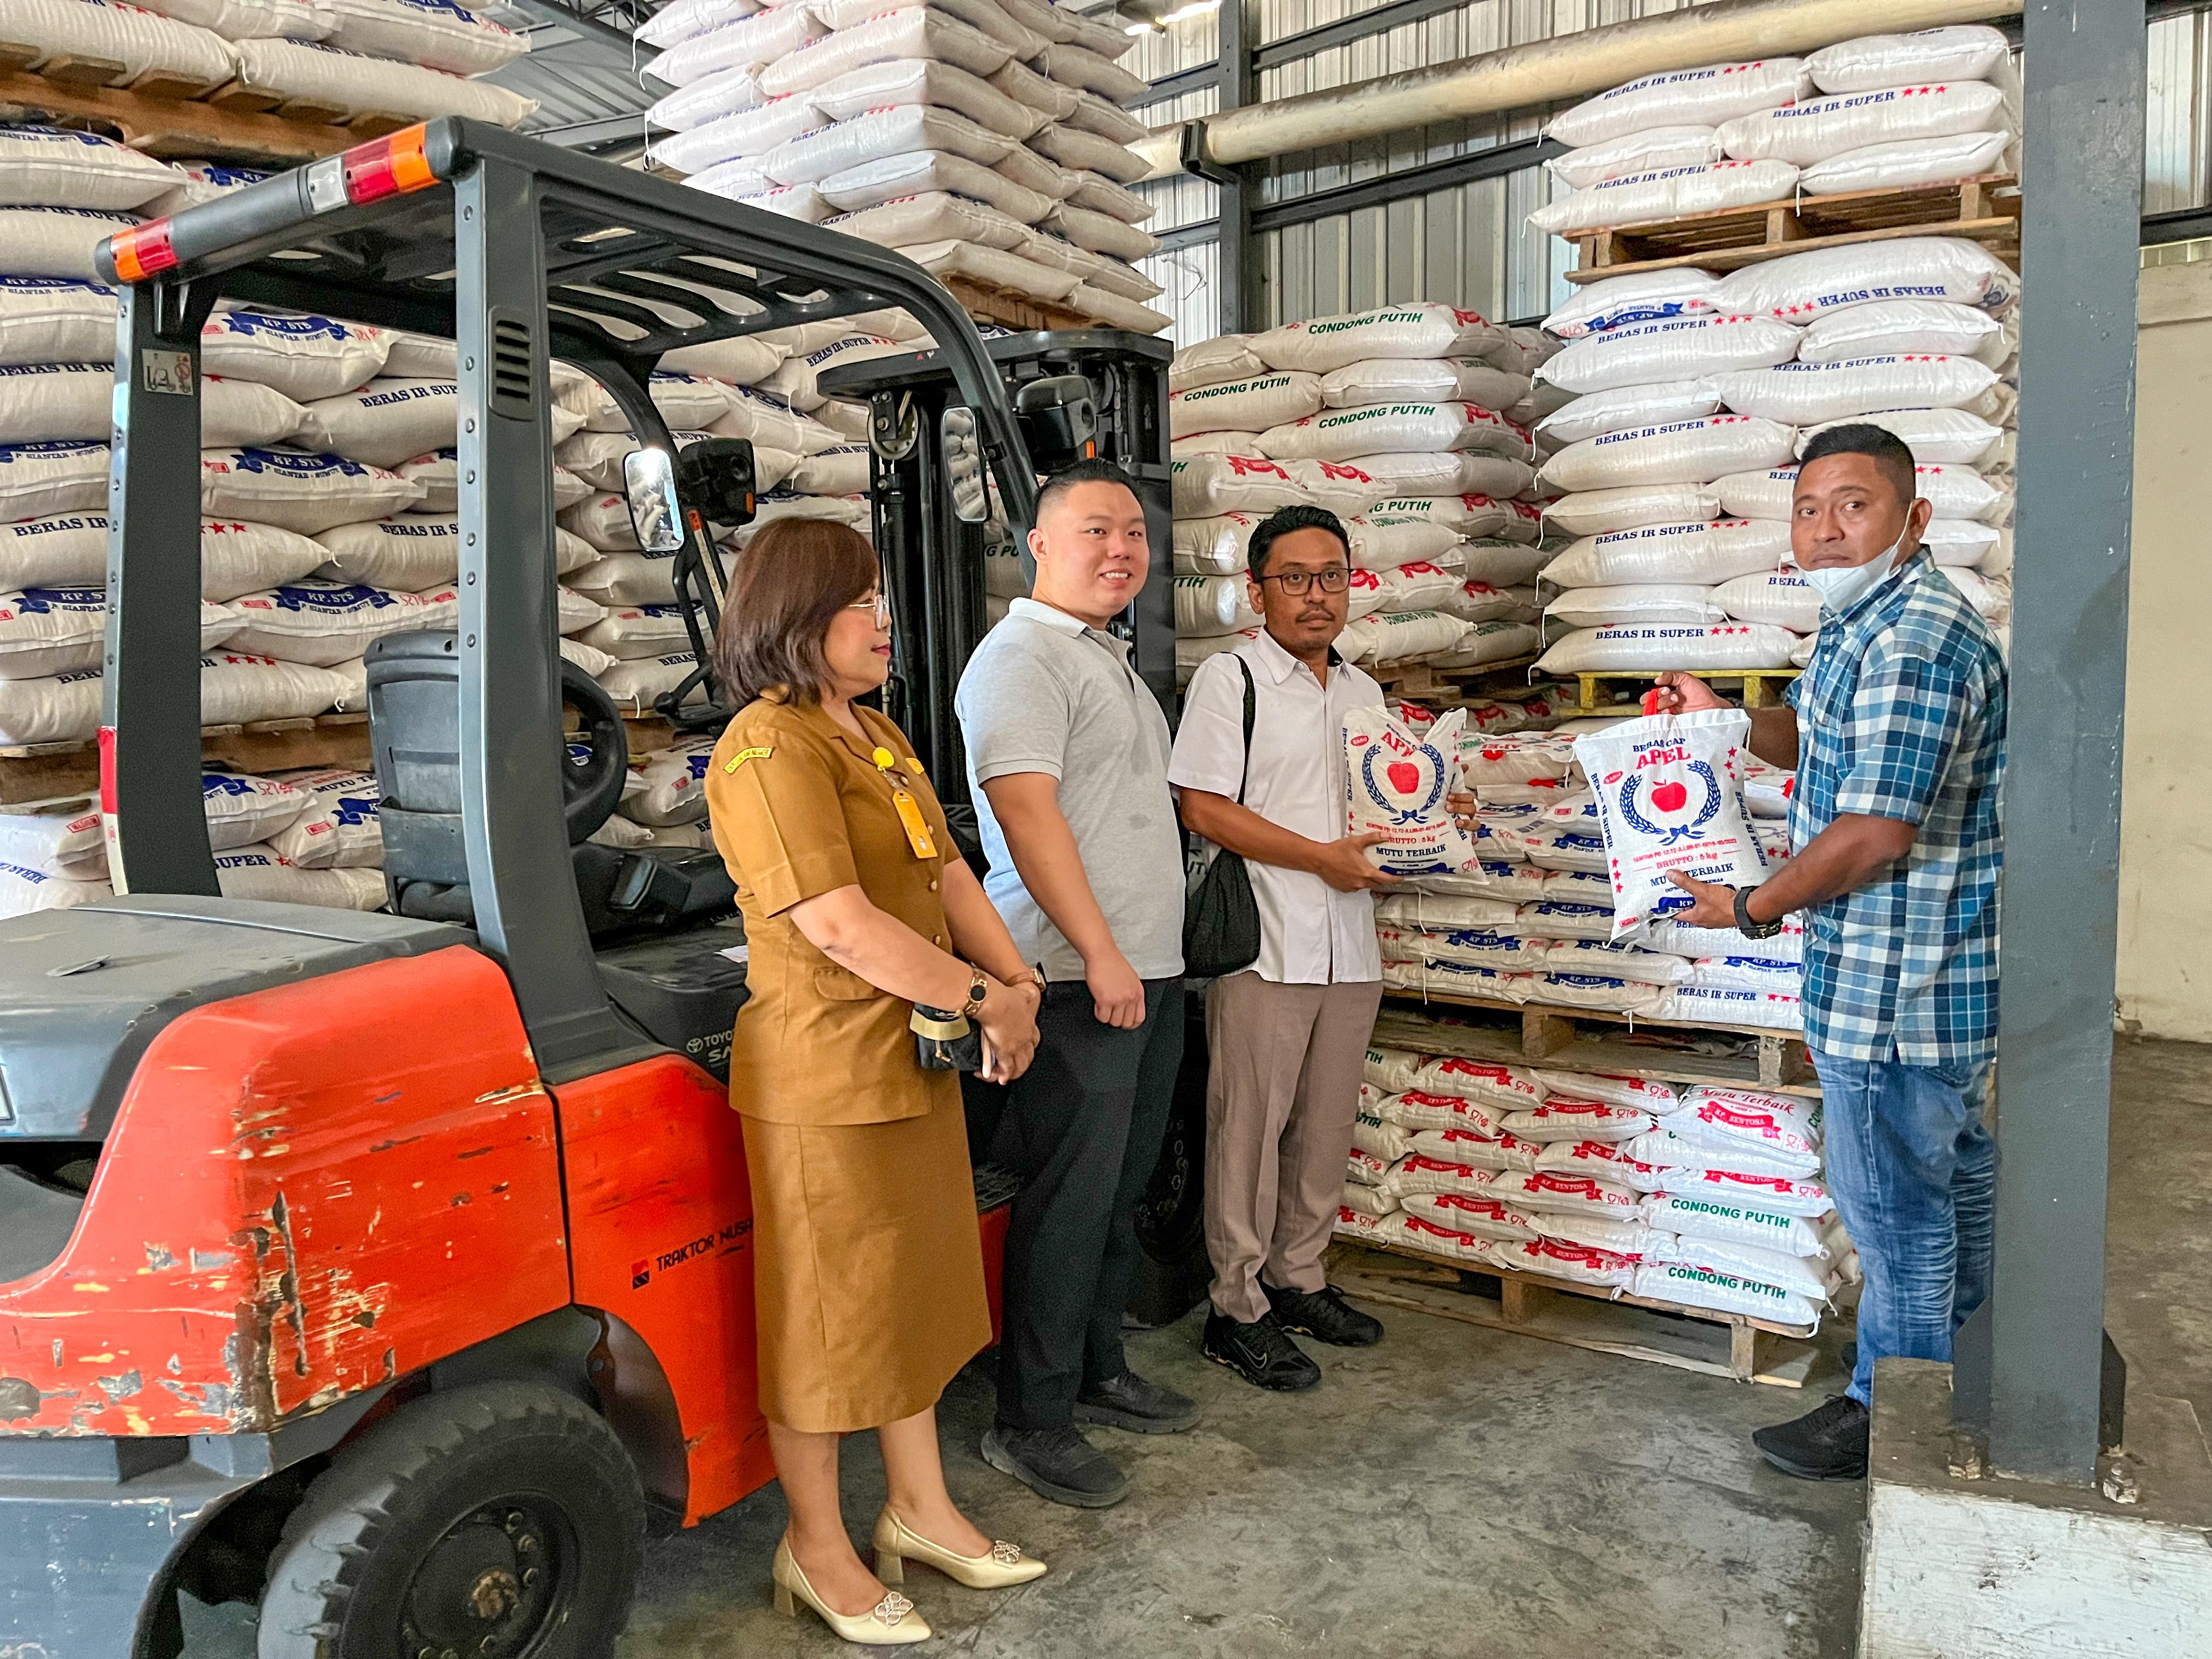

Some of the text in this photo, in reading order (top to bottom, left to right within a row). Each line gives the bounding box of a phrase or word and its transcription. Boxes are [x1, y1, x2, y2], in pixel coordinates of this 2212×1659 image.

[1604, 70, 1716, 100] BERAS IR SUPER
[1773, 91, 1895, 118] BERAS IR SUPER
[1594, 175, 1638, 191] BERAS
[1643, 173, 1656, 182] IR
[1818, 285, 1947, 307] BERAS IR SUPER
[1308, 313, 1423, 335] CONDONG PUTIH
[1597, 320, 1707, 345] BERAS IR SUPER
[806, 337, 871, 368] BERAS IR SUPER
[1825, 362, 1841, 370] IR
[1845, 356, 1896, 368] SUPER
[358, 385, 458, 408] BERAS IR SUP
[1184, 376, 1291, 402] CONDONG PUTIH
[1319, 405, 1436, 429] CONDONG PUTIH
[1595, 420, 1705, 446] BERAS IR SUPER
[1769, 472, 1798, 480] BER
[1388, 501, 1432, 512] PUTIH
[13, 517, 108, 537] BERAS IR
[379, 523, 448, 536] BERAS IR
[1595, 523, 1705, 545] BERAS IR SUPER
[1768, 577, 1810, 586] BERA
[1595, 628, 1705, 640] BERAS IR SUPER
[57, 670, 103, 685] BER
[1633, 738, 1686, 753] BERAS CAP
[1636, 746, 1691, 770] APEL
[1602, 816, 1613, 849] SUPER
[1376, 844, 1446, 857] MUTU TERBAIK
[1656, 855, 1694, 869] BRUTTO
[1705, 852, 1718, 860] kg
[1650, 862, 1734, 887] MU TERBAIK
[1677, 988, 1757, 1001] BERAS IR SUPER
[704, 1029, 733, 1047] TOYO
[1741, 1092, 1796, 1116] Terbaik
[1729, 1115, 1765, 1125] SENTOSA
[1555, 1182, 1588, 1190] SENTOSA
[1671, 1199, 1791, 1229] CONDONG PUTIH
[655, 1217, 753, 1272] TRAKTOR NUSA
[1668, 1267, 1787, 1300] CONDONG PUTIH
